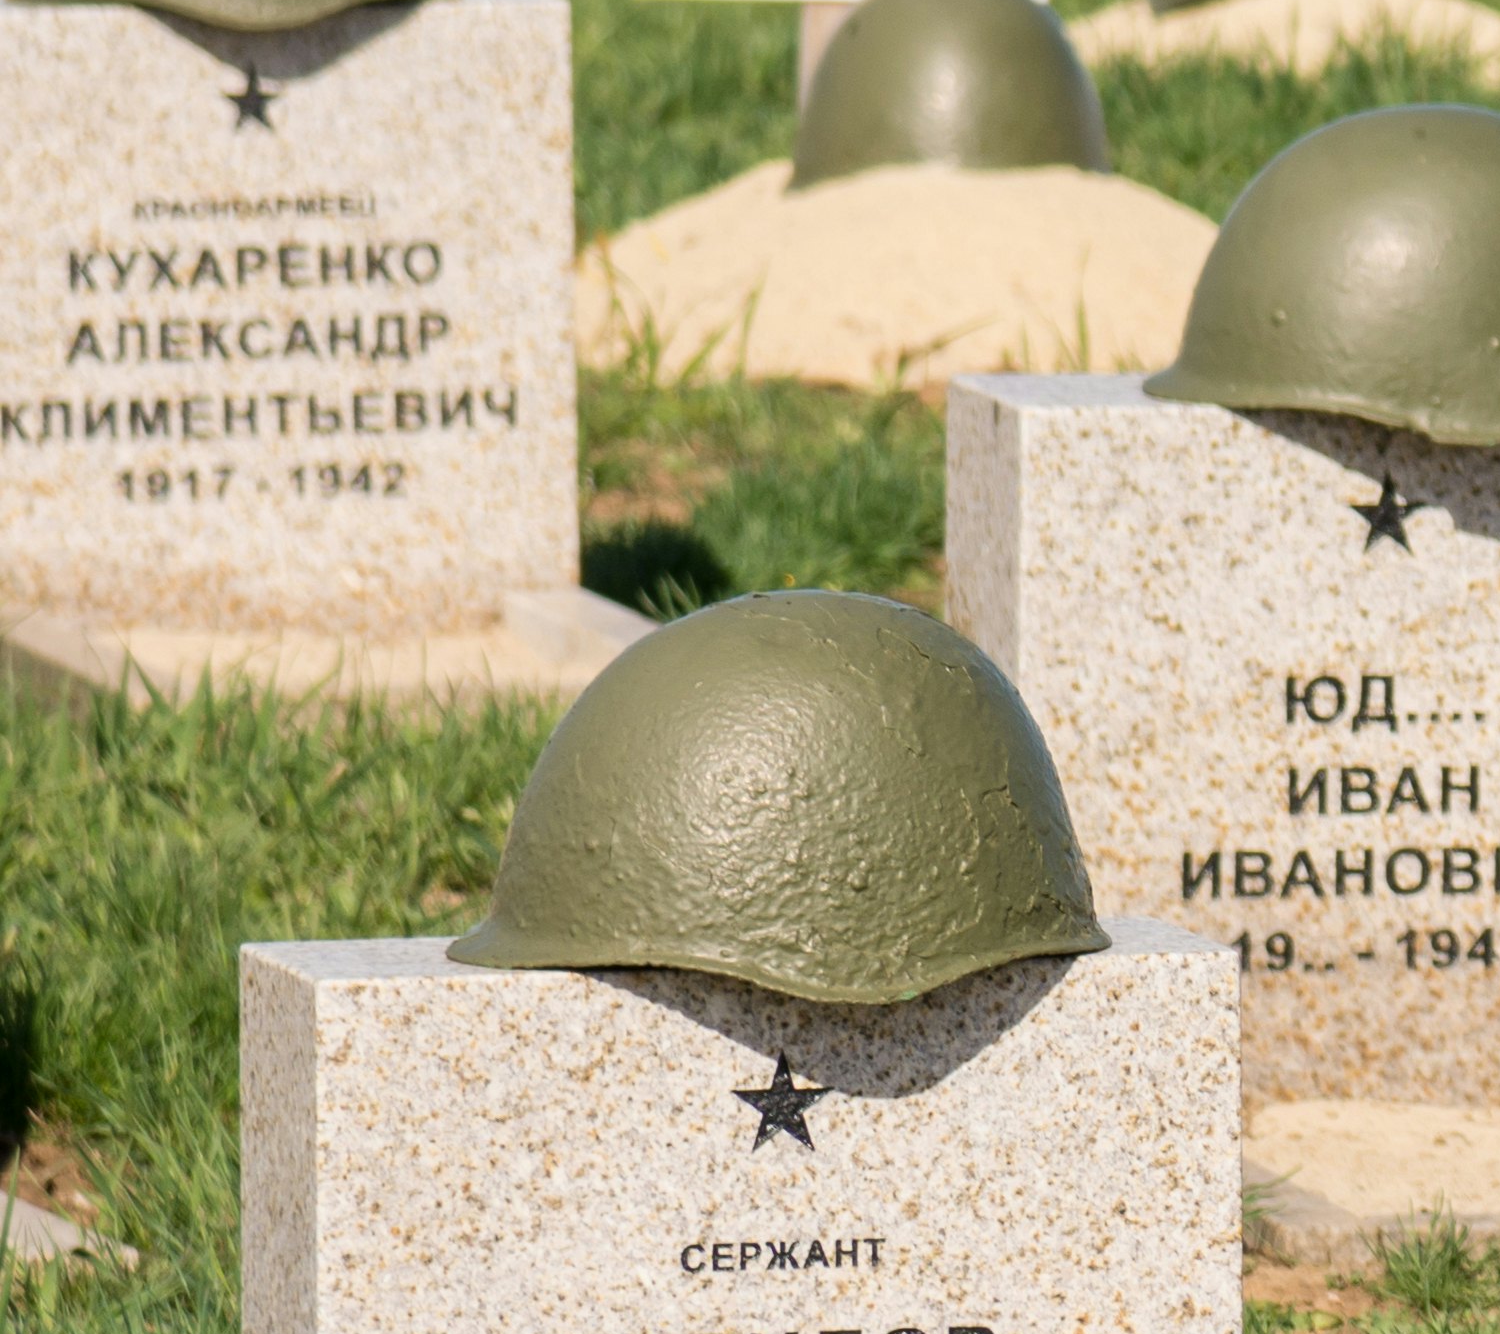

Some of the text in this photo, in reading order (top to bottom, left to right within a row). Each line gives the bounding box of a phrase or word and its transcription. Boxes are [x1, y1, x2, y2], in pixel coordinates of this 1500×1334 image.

[134, 195, 377, 221] КРАСНОАРМЕЕЦ
[68, 241, 442, 291] КУХАРЕНКО
[67, 311, 451, 364] АЛЕКСАНДР
[0, 387, 518, 443] КЛИМЕНТЬЕВИЧ
[120, 468, 234, 500] 1917
[289, 463, 405, 494] 1942
[1289, 765, 1481, 816] ИВАН
[680, 1237, 886, 1273] СЕРЖАНТ
